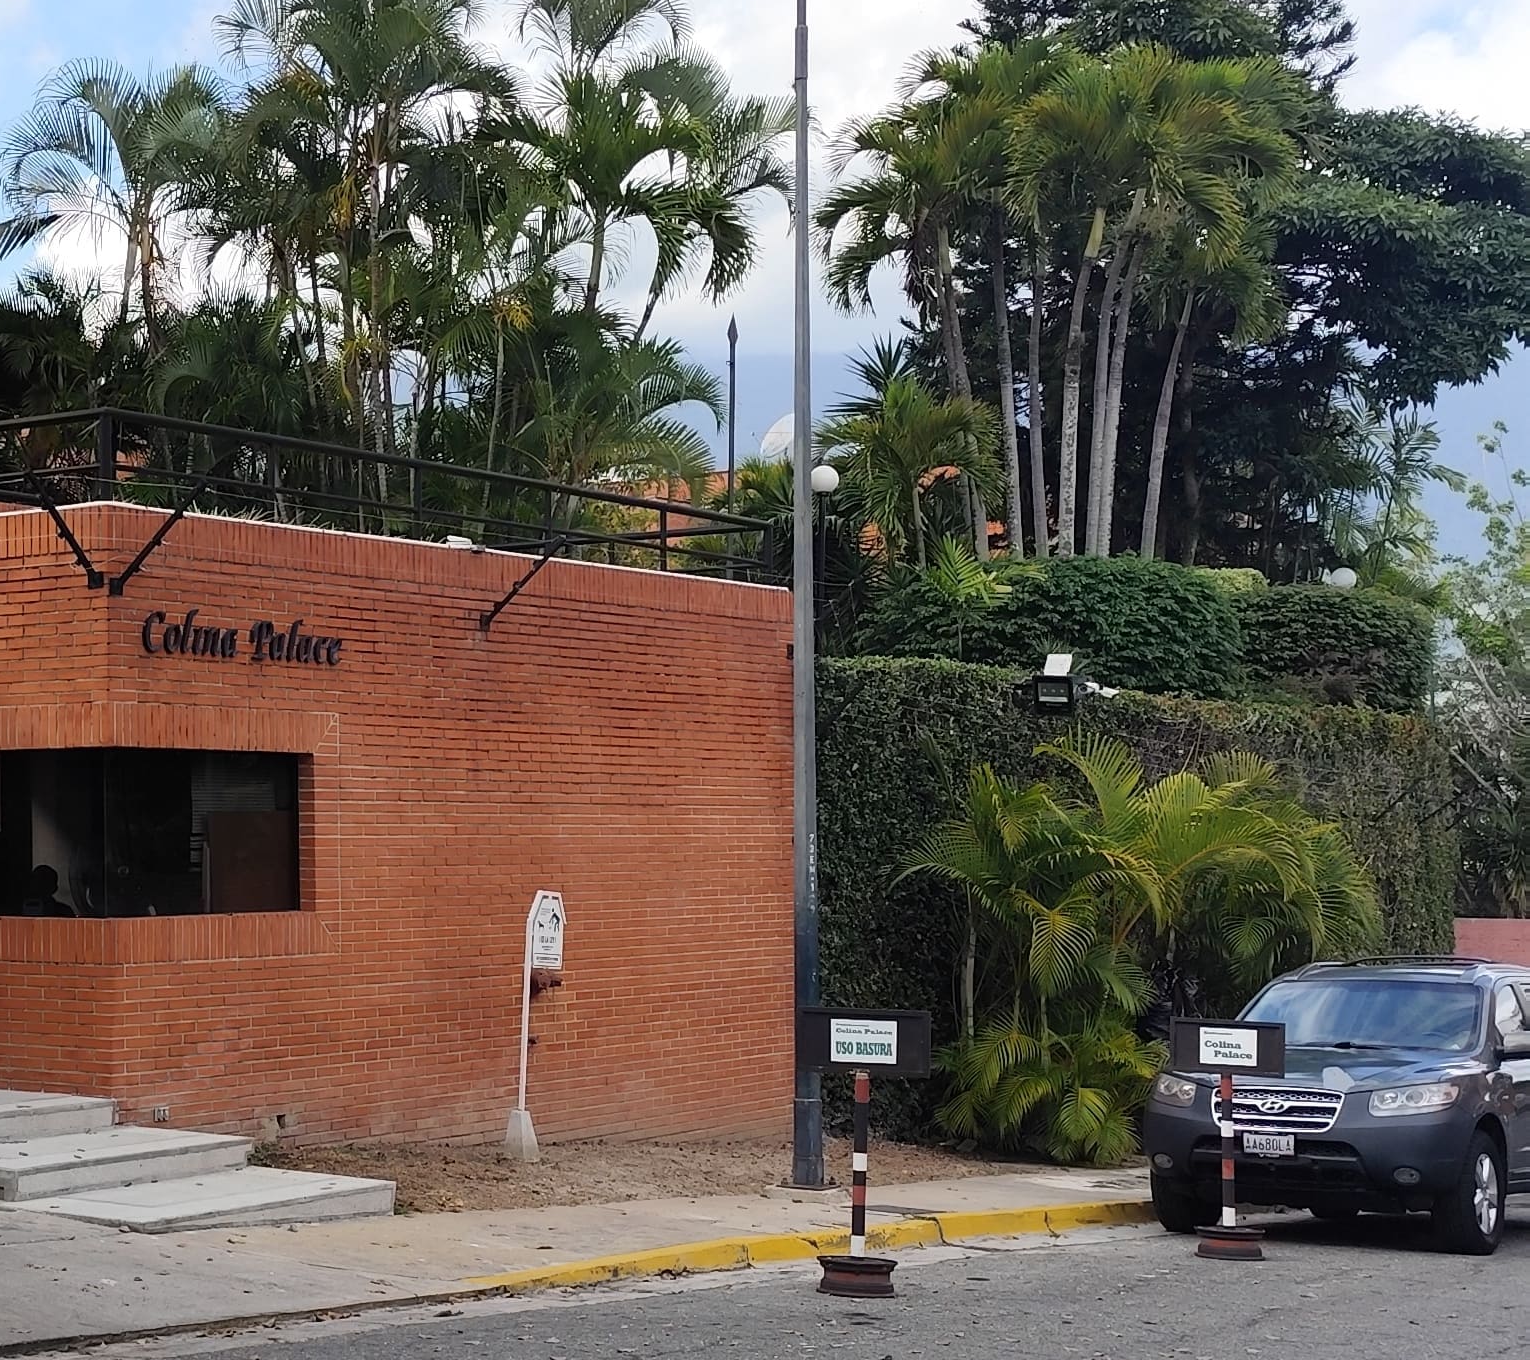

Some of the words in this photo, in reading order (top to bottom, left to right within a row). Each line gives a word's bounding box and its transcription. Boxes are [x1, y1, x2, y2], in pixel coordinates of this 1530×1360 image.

[141, 608, 239, 658] Colina
[248, 619, 343, 666] Palace
[835, 1040, 854, 1055] USO
[855, 1041, 893, 1057] BASURA
[1204, 1040, 1242, 1050] Colina
[1214, 1049, 1253, 1060] Palace
